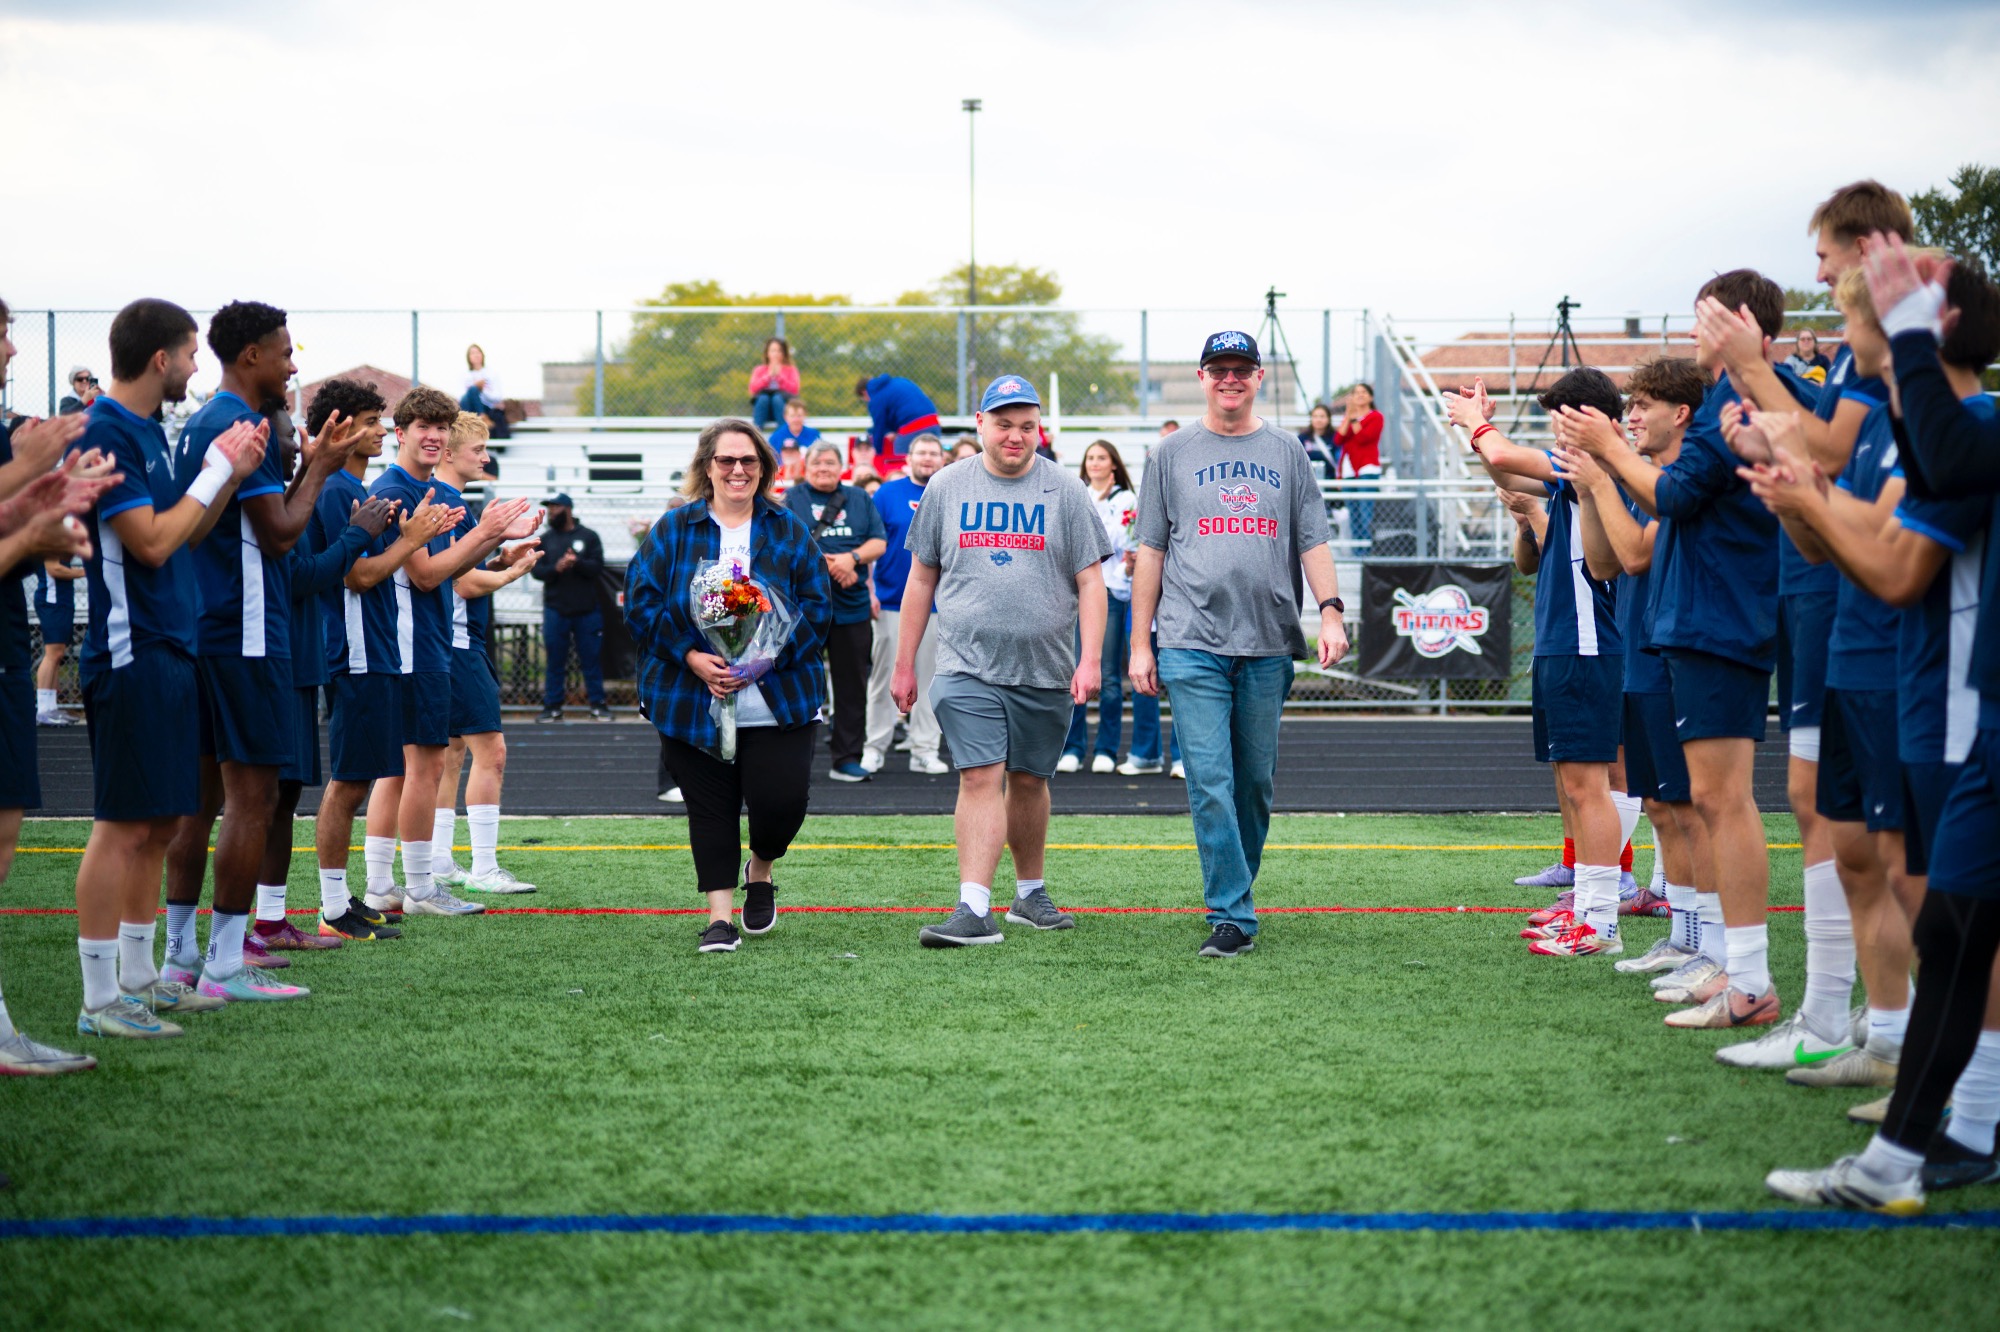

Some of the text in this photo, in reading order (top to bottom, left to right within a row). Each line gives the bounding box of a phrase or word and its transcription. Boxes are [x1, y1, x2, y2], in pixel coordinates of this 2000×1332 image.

[1194, 460, 1281, 488] TITANS
[1220, 493, 1257, 503] TITANS
[959, 501, 1045, 535] UDM
[1198, 516, 1278, 539] SOCCER
[961, 533, 1042, 550] MEN'S SOCCER
[1397, 611, 1484, 631] TITANS
